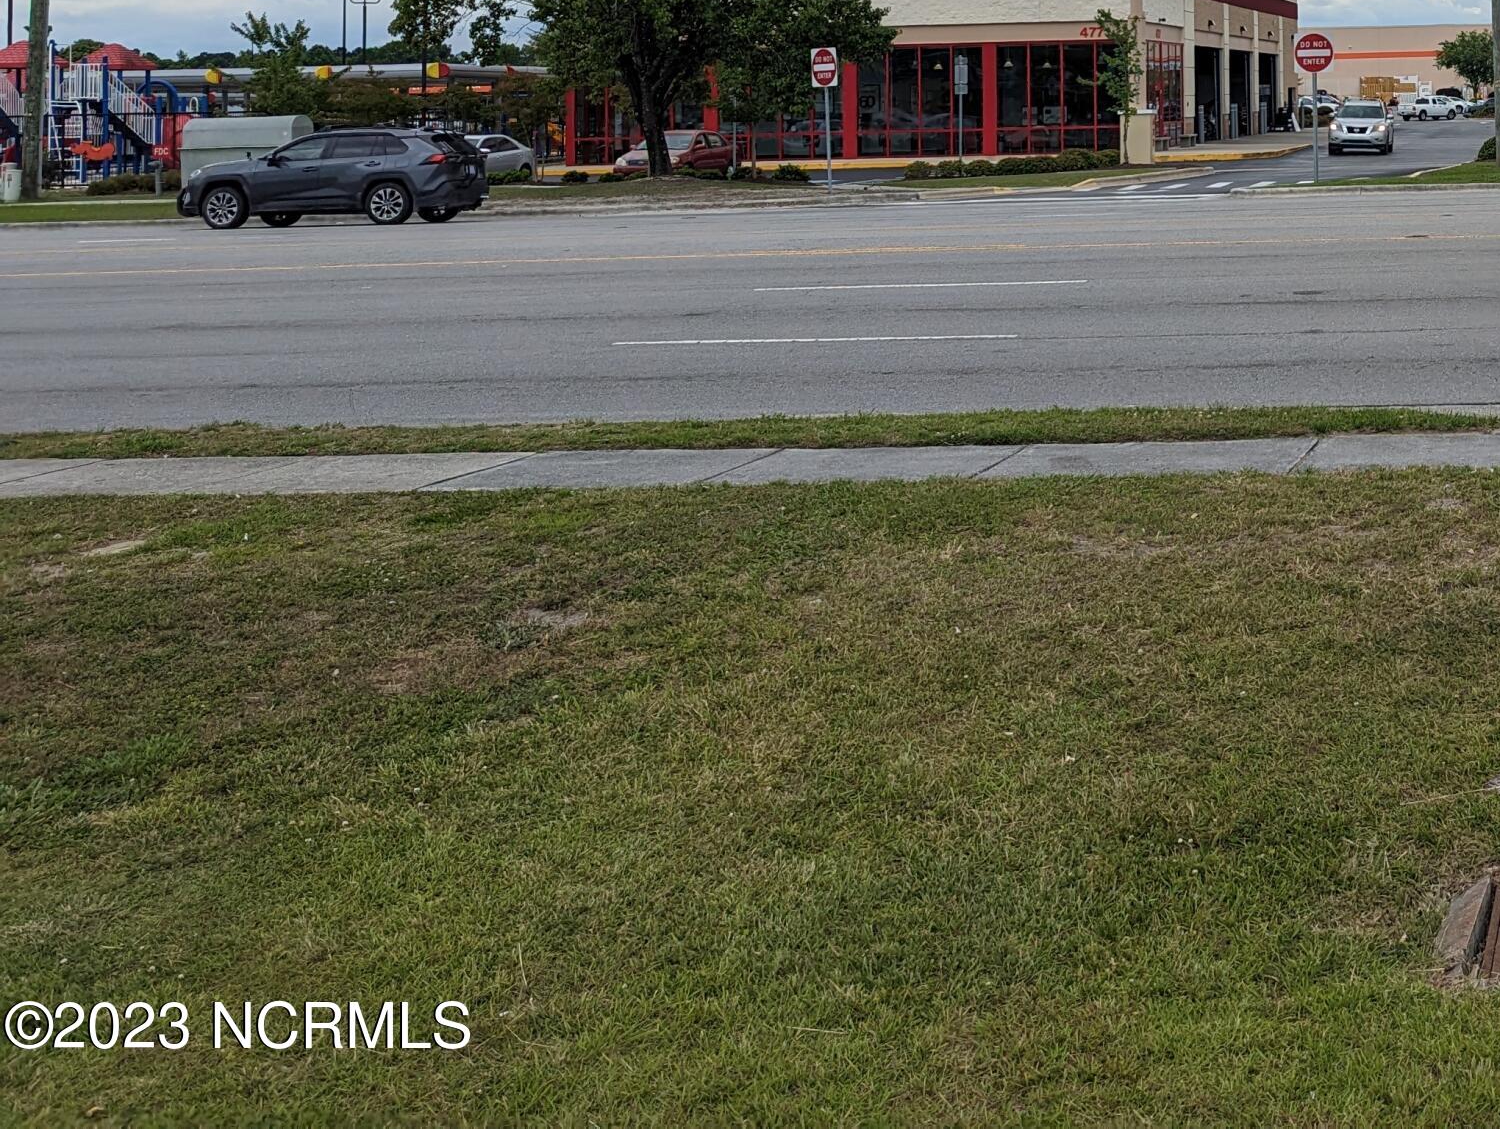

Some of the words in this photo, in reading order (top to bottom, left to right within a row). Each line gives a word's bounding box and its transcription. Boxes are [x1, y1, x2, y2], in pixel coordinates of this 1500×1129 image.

[1312, 40, 1328, 48] NOT
[822, 55, 833, 63] NOT
[817, 71, 832, 79] ENTER
[154, 147, 169, 156] FDC
